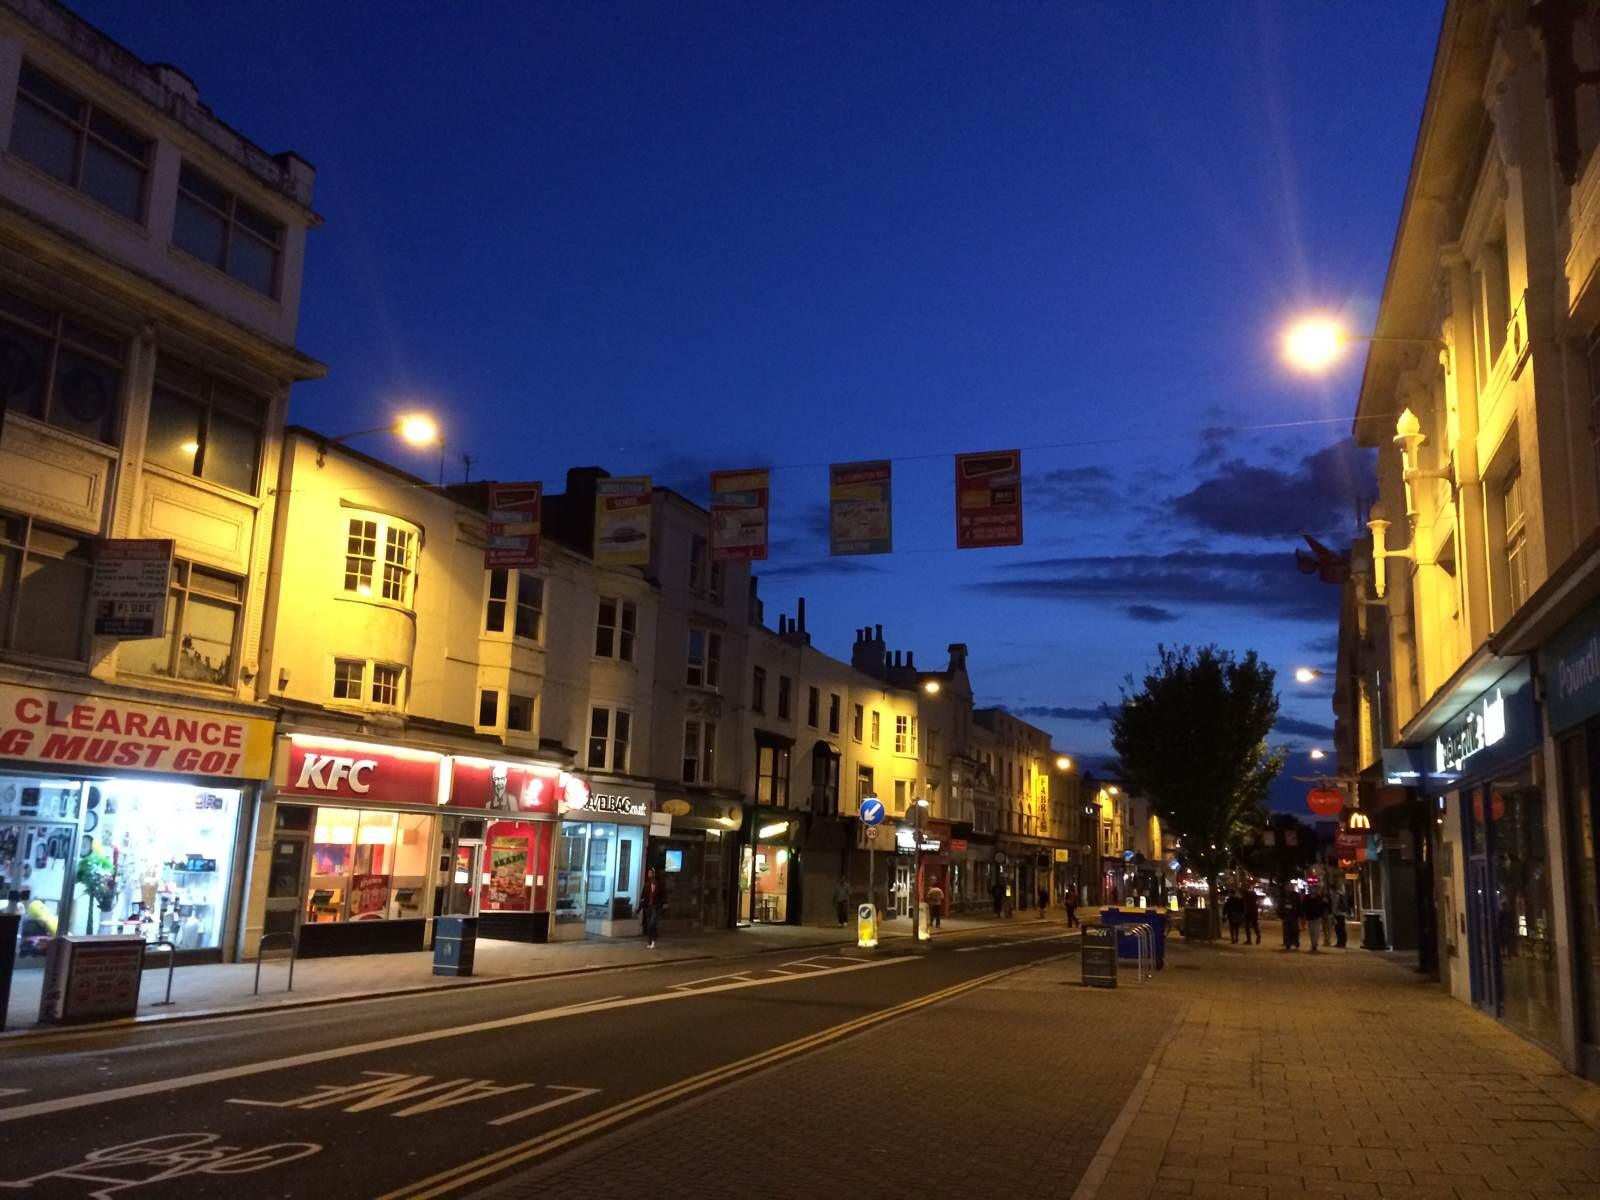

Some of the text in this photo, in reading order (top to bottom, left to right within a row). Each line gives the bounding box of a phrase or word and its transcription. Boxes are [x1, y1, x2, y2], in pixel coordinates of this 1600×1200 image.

[14, 697, 243, 748] CLEARANCE
[39, 733, 170, 768] MUST
[172, 747, 241, 774] GO!
[295, 752, 378, 793] KFC
[225, 1071, 602, 1126] LANE
